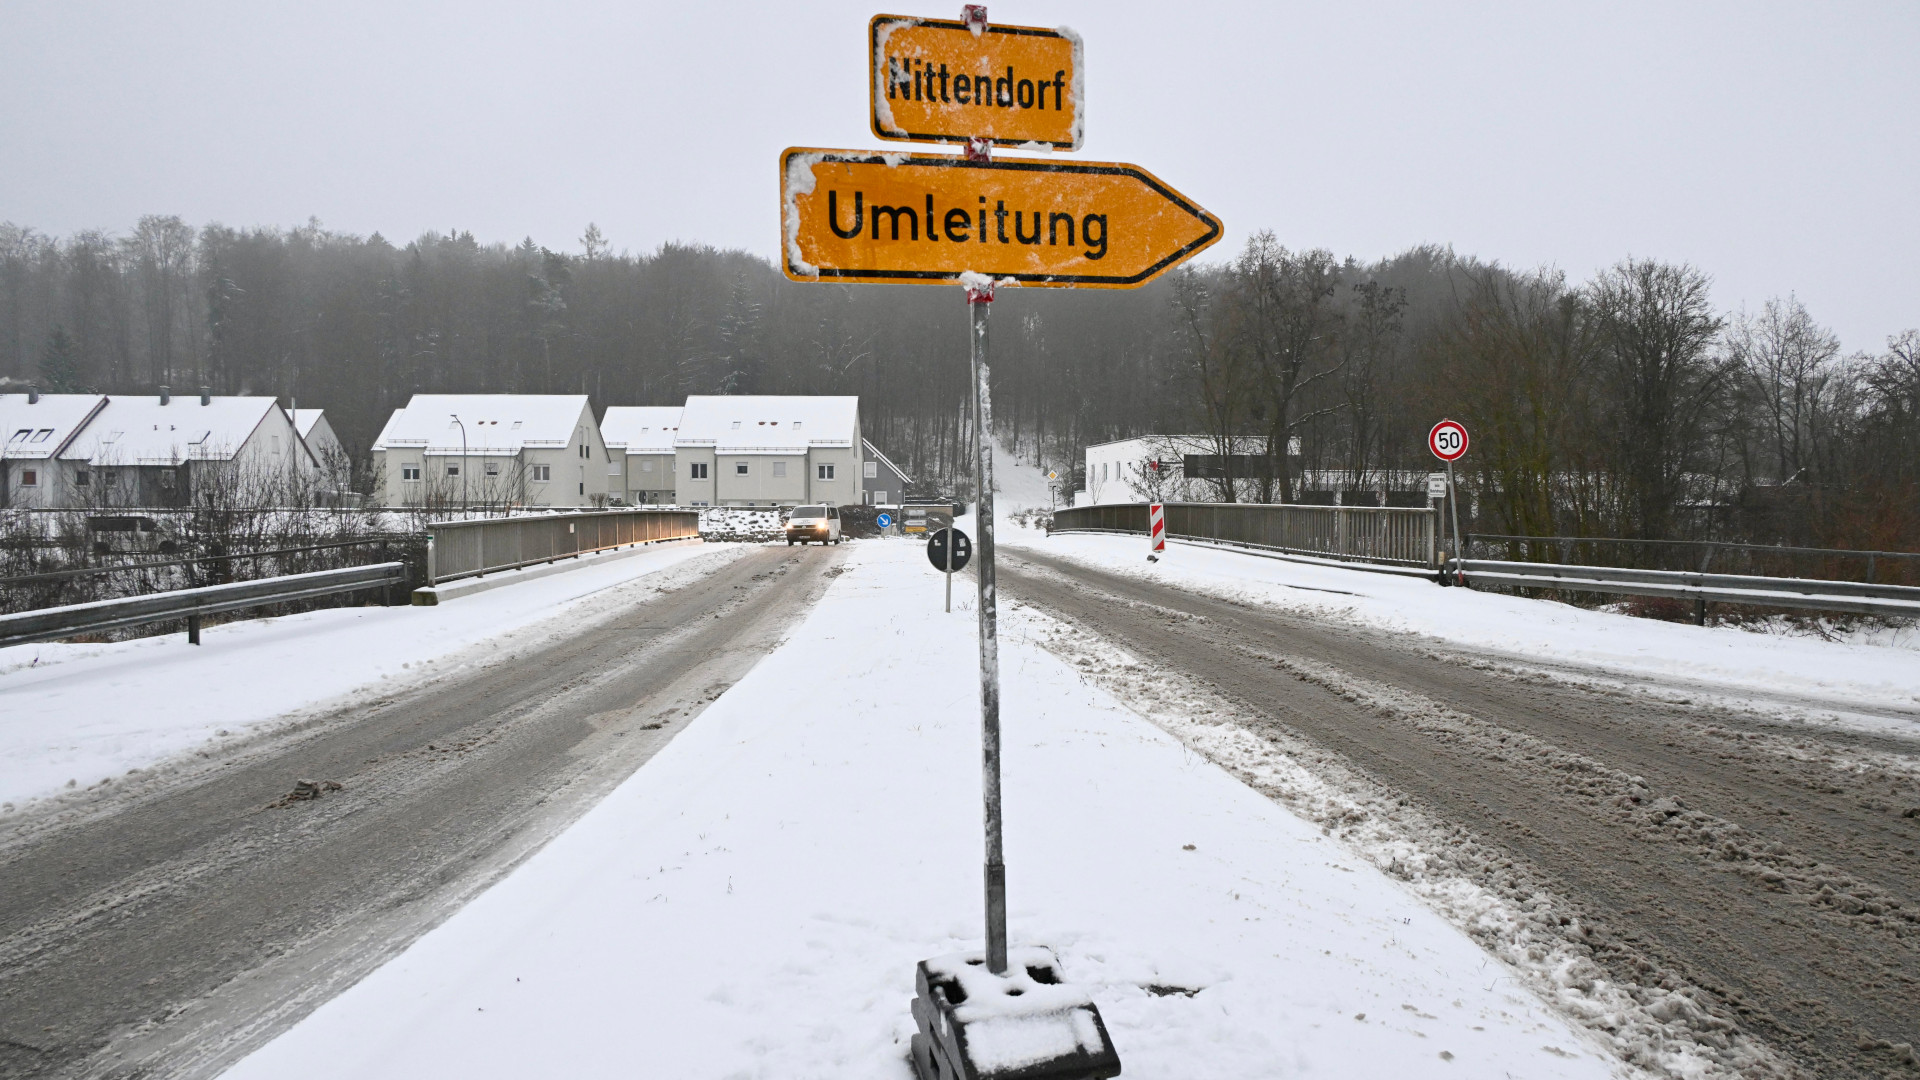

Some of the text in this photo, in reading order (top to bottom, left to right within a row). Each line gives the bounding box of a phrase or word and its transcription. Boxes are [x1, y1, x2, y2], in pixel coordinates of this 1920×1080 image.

[889, 56, 1065, 111] Nittendorf
[828, 190, 1108, 260] Umleitung
[1438, 431, 1460, 450] 50
